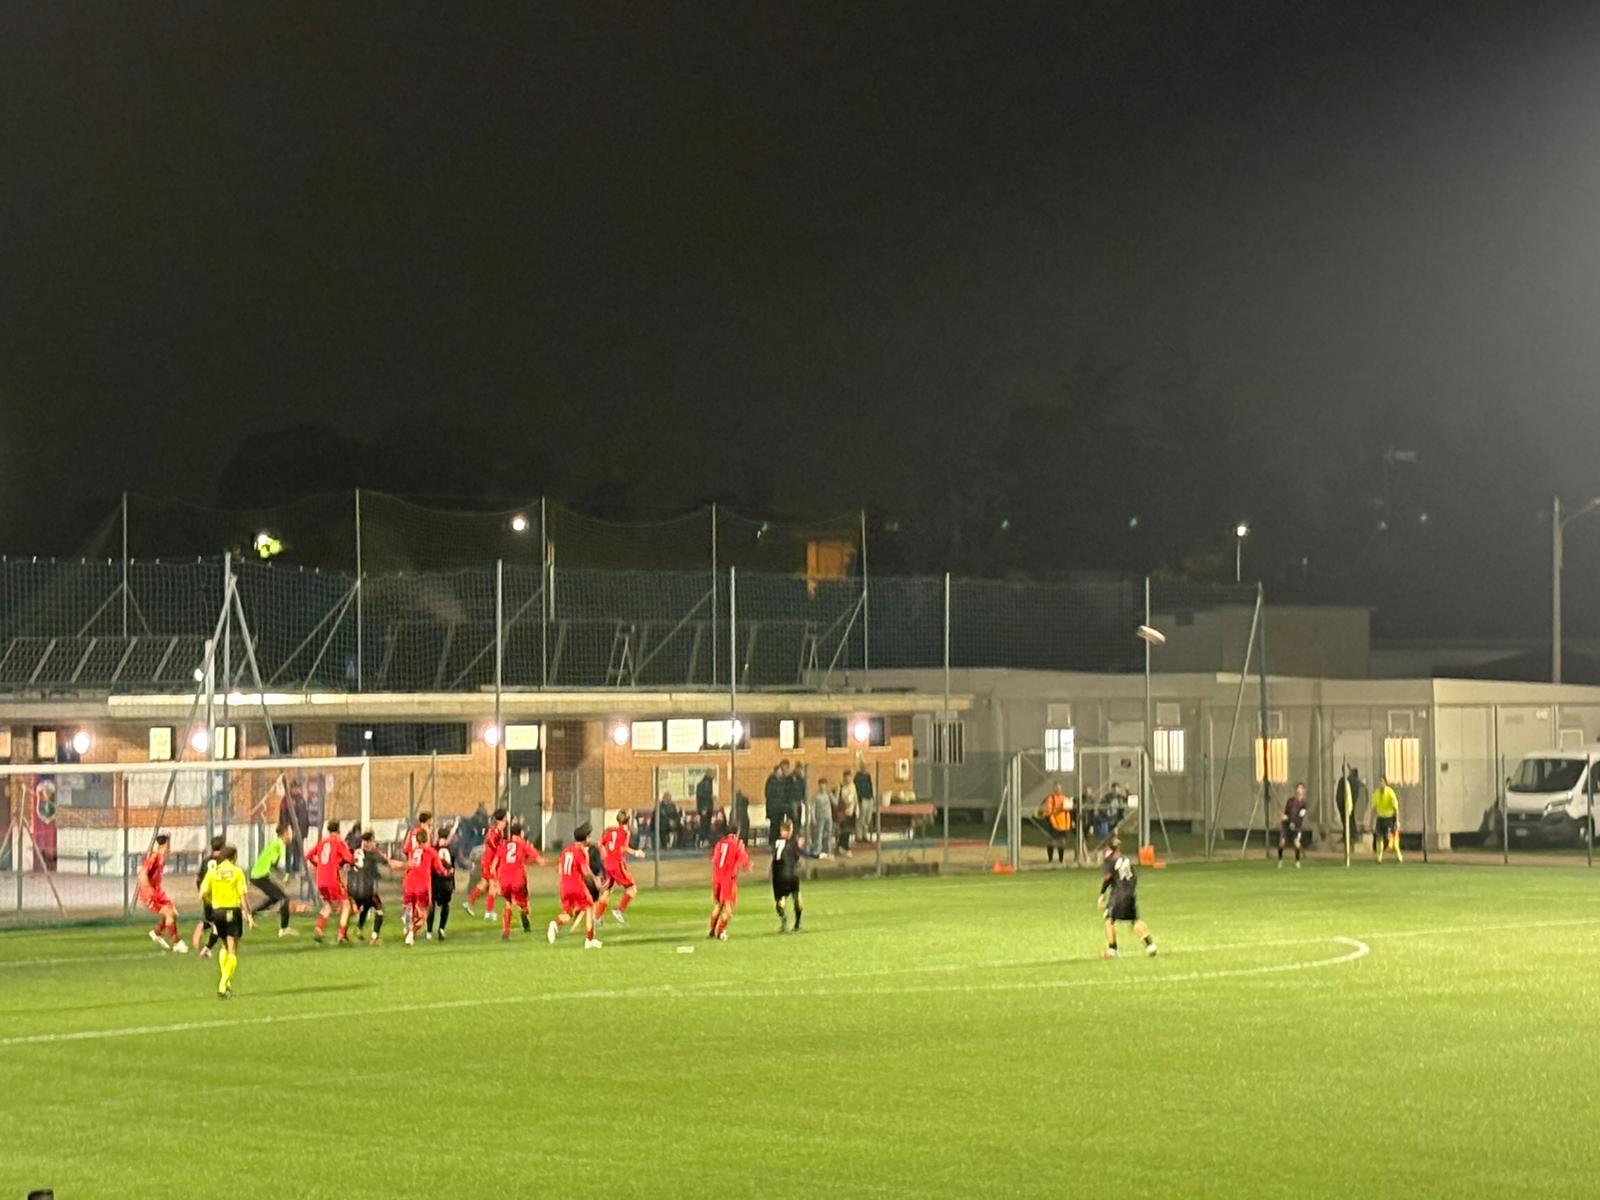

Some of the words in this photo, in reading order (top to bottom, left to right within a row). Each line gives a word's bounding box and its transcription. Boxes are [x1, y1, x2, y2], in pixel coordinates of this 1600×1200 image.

[506, 842, 516, 863] 2
[719, 842, 729, 868] 7
[775, 839, 786, 861] 7
[564, 852, 574, 876] 11
